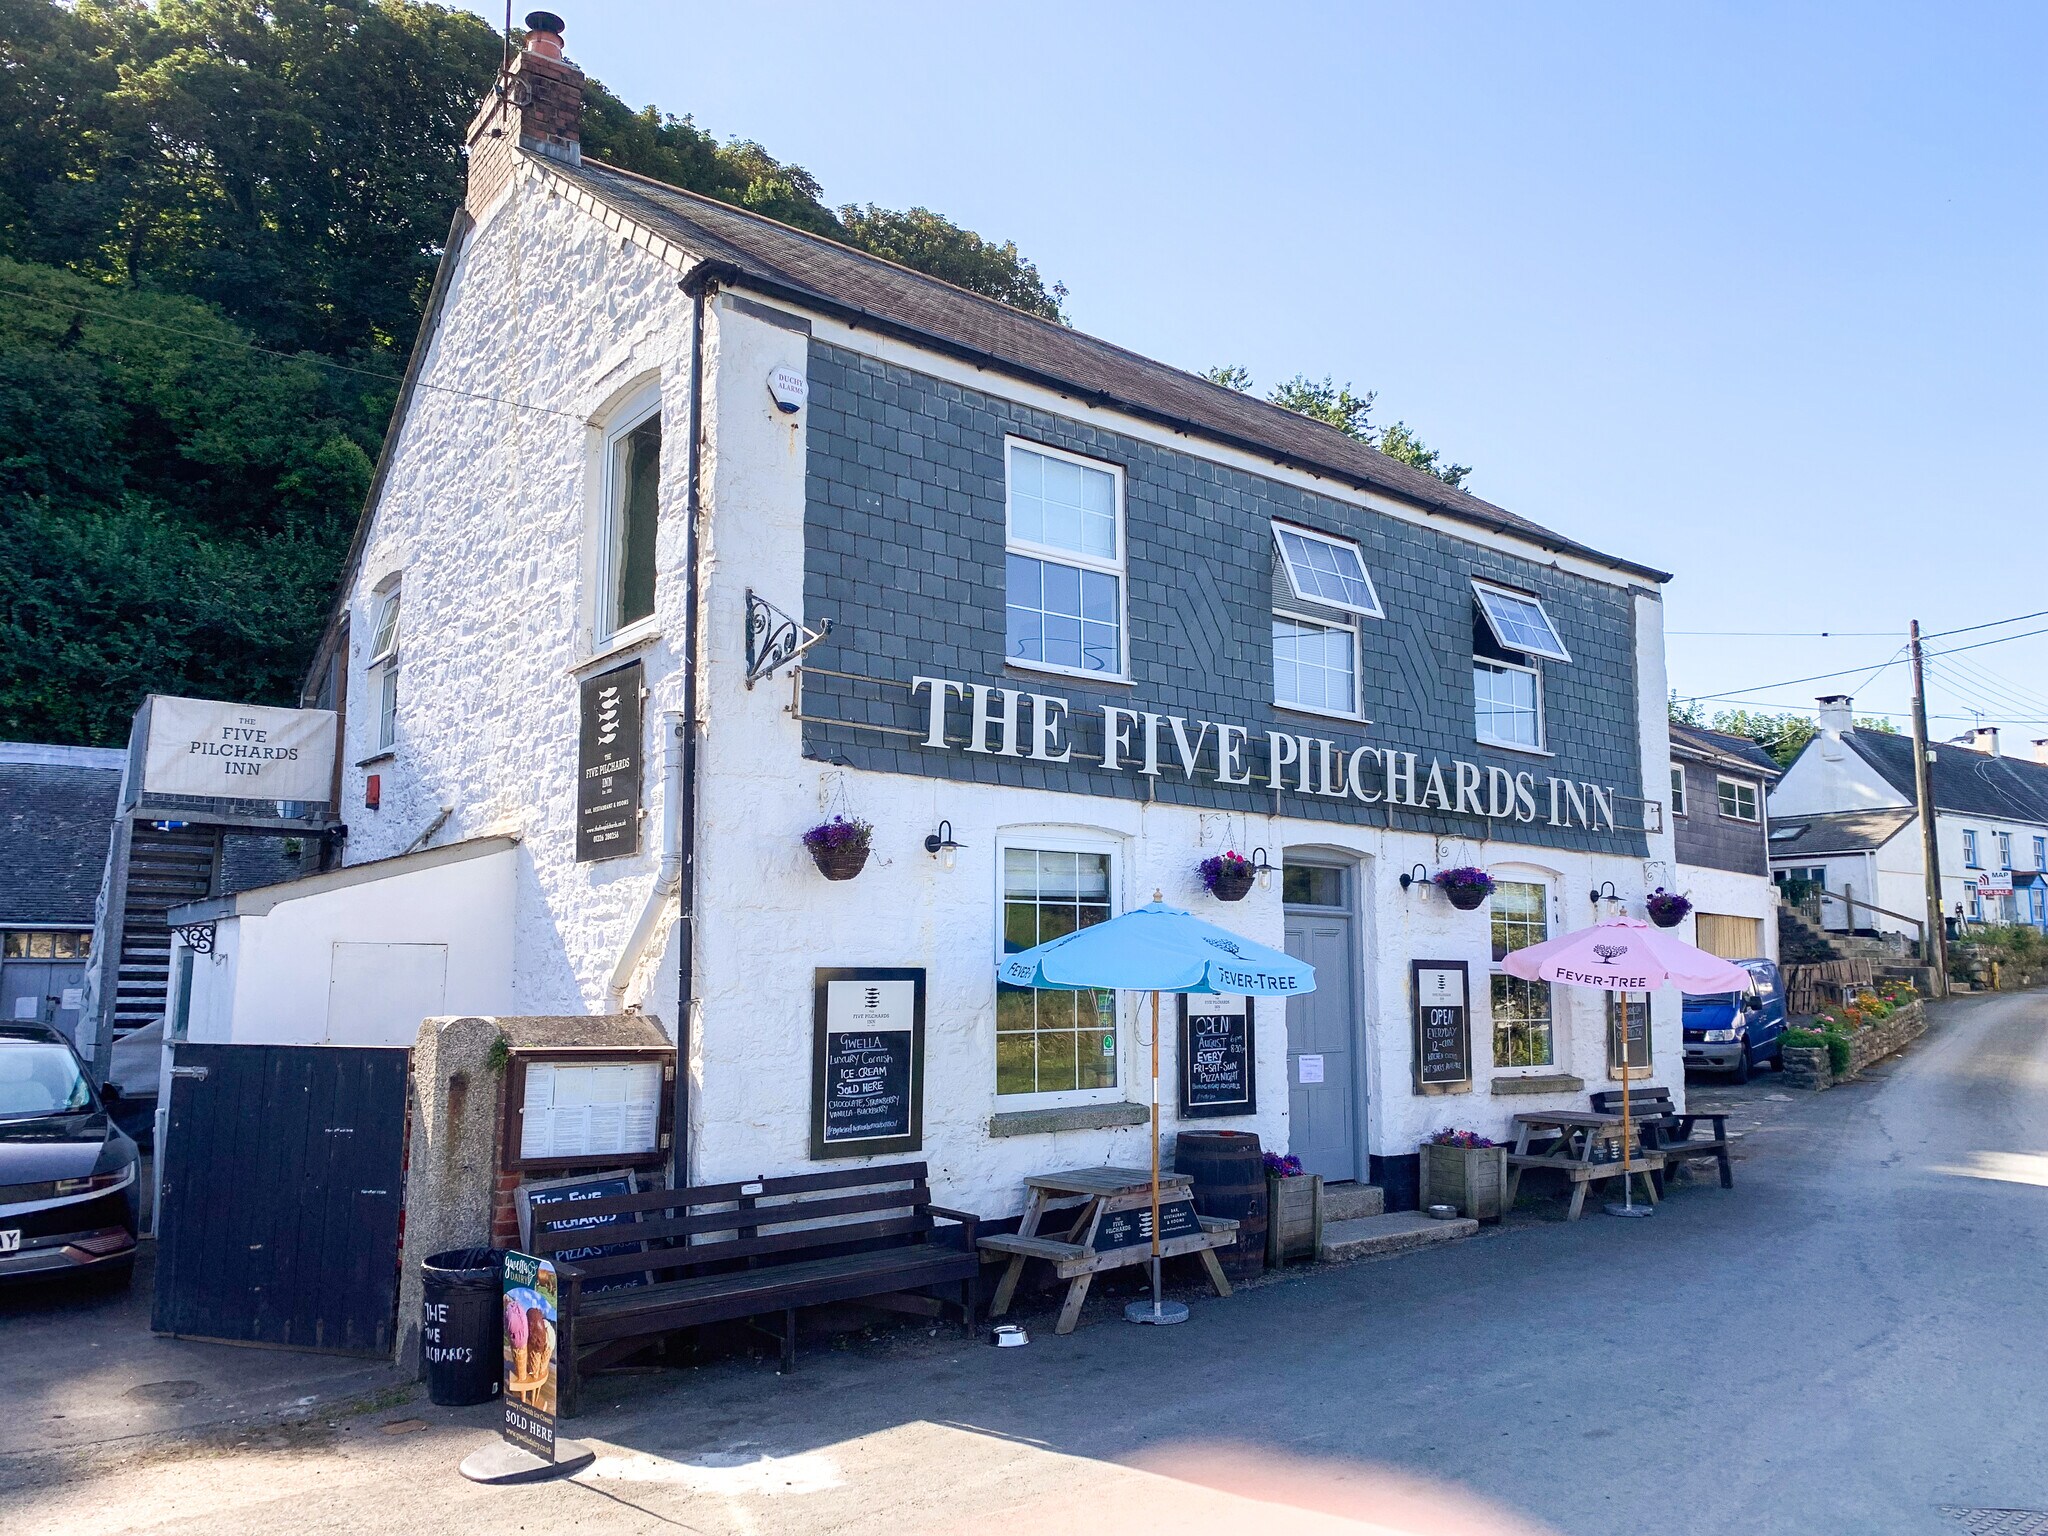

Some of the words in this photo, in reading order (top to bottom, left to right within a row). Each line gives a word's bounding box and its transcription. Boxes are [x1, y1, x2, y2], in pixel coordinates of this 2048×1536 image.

[779, 374, 803, 387] DUCHY
[778, 383, 804, 394] ALARMS
[239, 717, 256, 725] THE
[222, 727, 267, 743] FIVE
[189, 741, 298, 760] PILCHARDS
[911, 675, 1072, 763] THE
[1098, 704, 1251, 785] FIVE
[1265, 730, 1536, 823] PILCHARDS
[1546, 776, 1615, 834] INN
[225, 761, 261, 775] INN
[586, 767, 599, 778] FIVE
[600, 758, 630, 774] PILCHARDS
[602, 776, 612, 788] INN
[1556, 968, 1647, 988] FEVER-TREE
[1431, 1009, 1454, 1025] OPEN
[1196, 1016, 1230, 1034] OPEN
[840, 1034, 882, 1049] GWELLA
[1197, 1051, 1225, 1062] EVERY
[841, 1068, 855, 1079] ICE
[858, 1066, 887, 1078] CREAM
[836, 1082, 860, 1095] SOLD
[862, 1081, 884, 1092] HERE
[505, 1410, 527, 1430] SOLD
[529, 1420, 553, 1443] HERE
